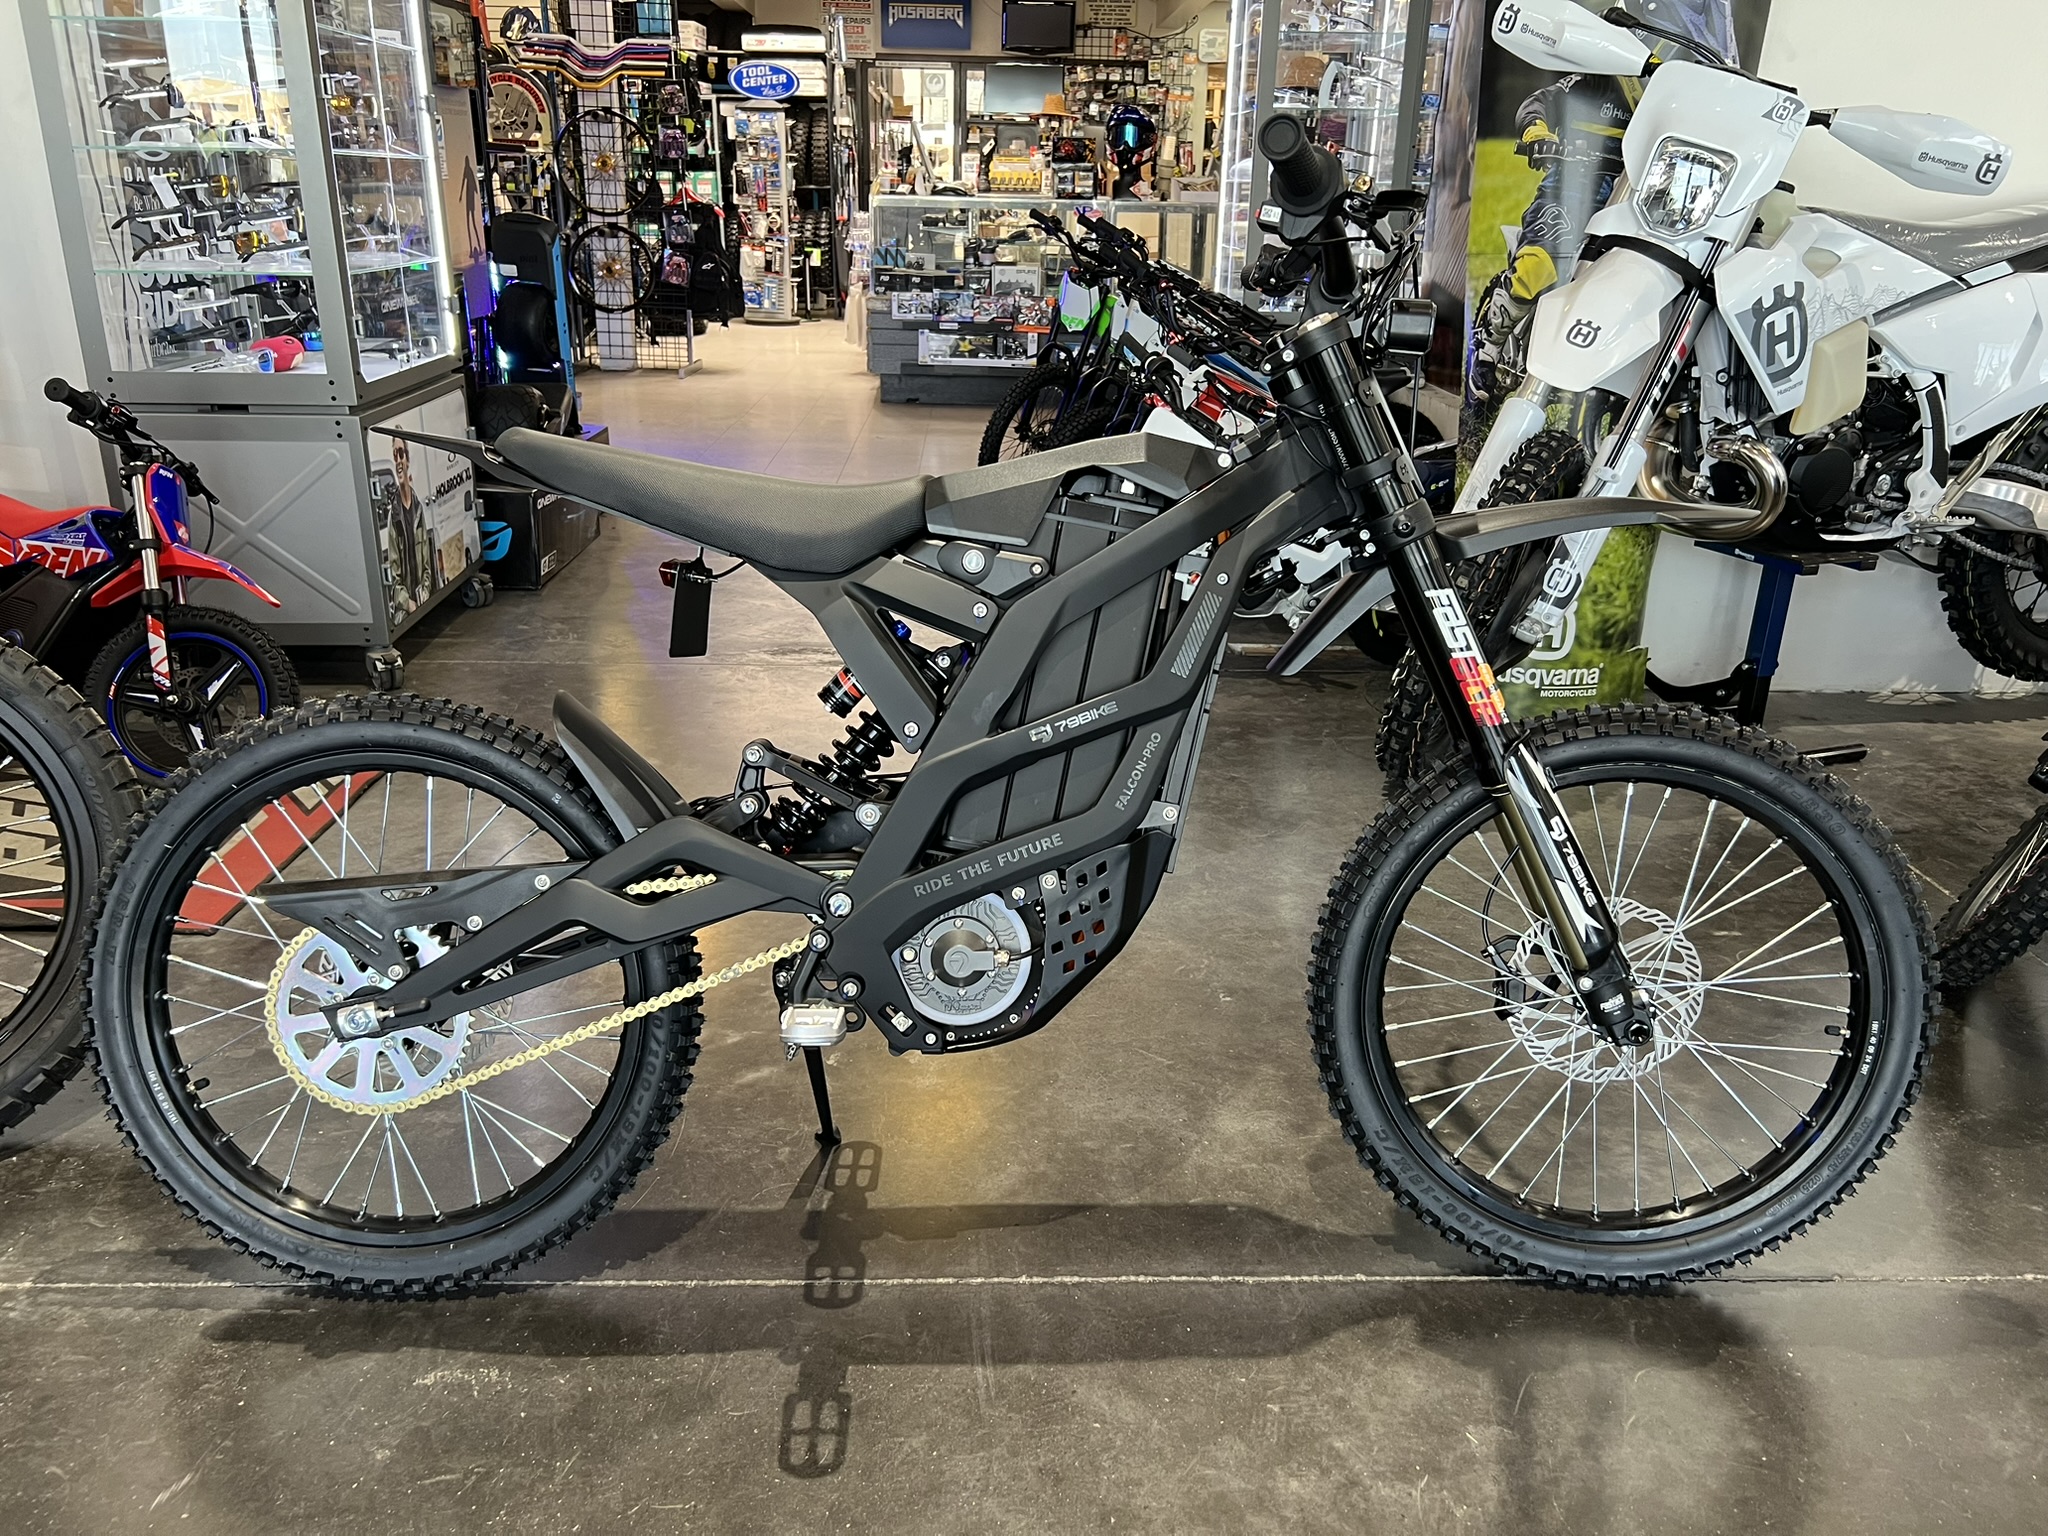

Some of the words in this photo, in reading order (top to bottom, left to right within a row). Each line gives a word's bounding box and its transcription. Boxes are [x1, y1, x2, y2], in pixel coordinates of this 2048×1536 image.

[888, 5, 964, 29] HUSABERG
[1527, 28, 1557, 46] Husqvarna
[741, 66, 772, 79] TOOL
[742, 74, 788, 88] CENTER
[1928, 155, 1969, 172] Husqvarna
[1777, 380, 1804, 396] Husqvarna
[1540, 688, 1597, 698] MOTORCYCLES
[1054, 701, 1119, 733] 79BIKE
[1114, 732, 1161, 811] FALCON-PRO
[913, 873, 954, 897] RIDE
[957, 859, 992, 880] THE
[997, 833, 1064, 867] FUTURE
[1562, 841, 1598, 908] 79BIKE
